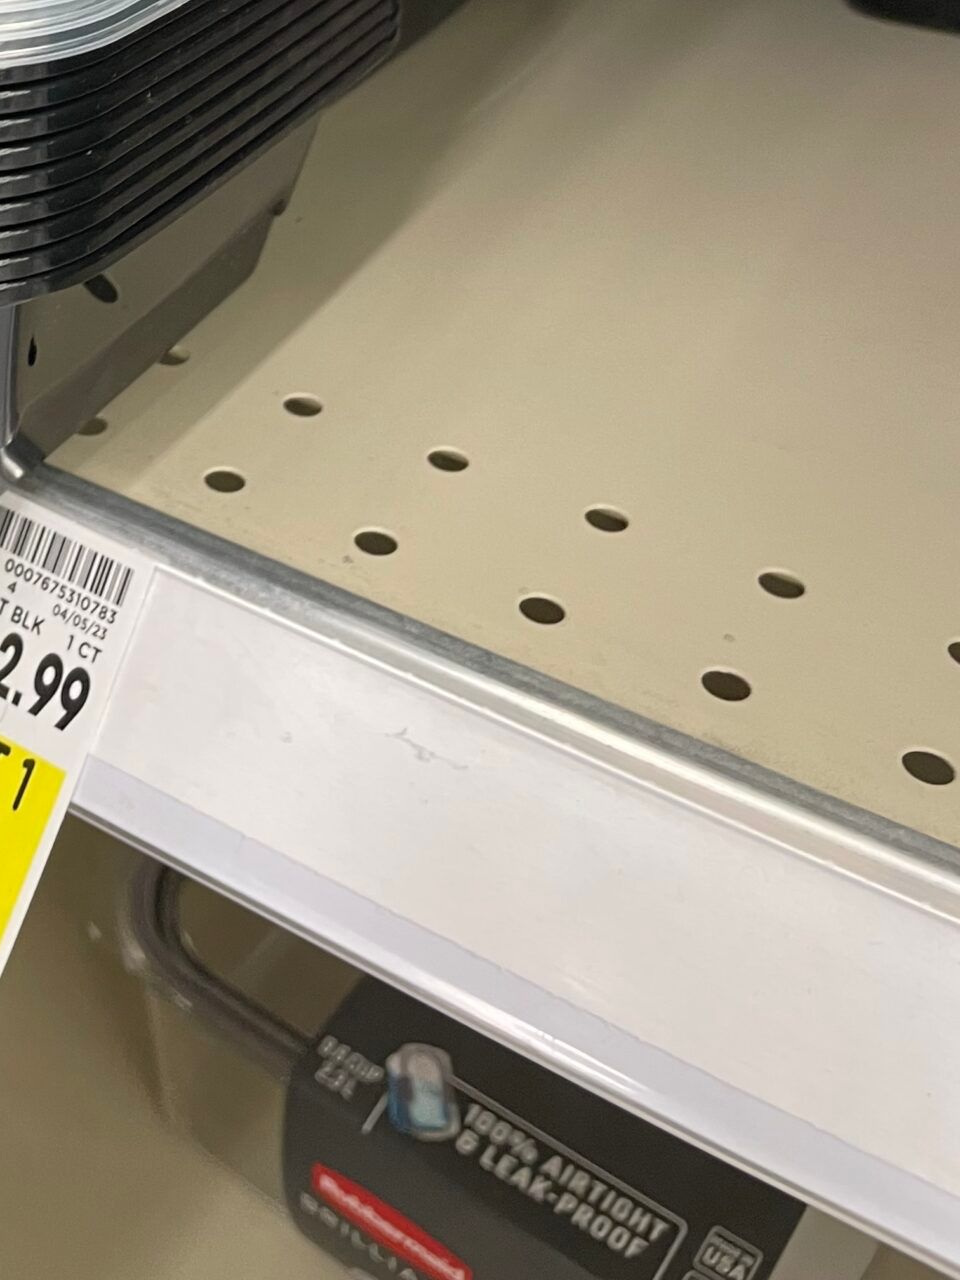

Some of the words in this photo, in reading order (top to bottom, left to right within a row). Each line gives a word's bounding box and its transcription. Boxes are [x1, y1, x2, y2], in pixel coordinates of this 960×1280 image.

[5, 558, 118, 624] 0007675310783
[7, 581, 18, 593] 4
[11, 605, 45, 636] BLK
[52, 603, 108, 640] 04/05/23
[66, 634, 75, 650] 1
[78, 641, 103, 663] CT
[12, 757, 37, 811] 1
[464, 1103, 538, 1165] 100%
[540, 1154, 671, 1242] AIRTIGHT
[479, 1144, 650, 1258] LEAK-PROOF
